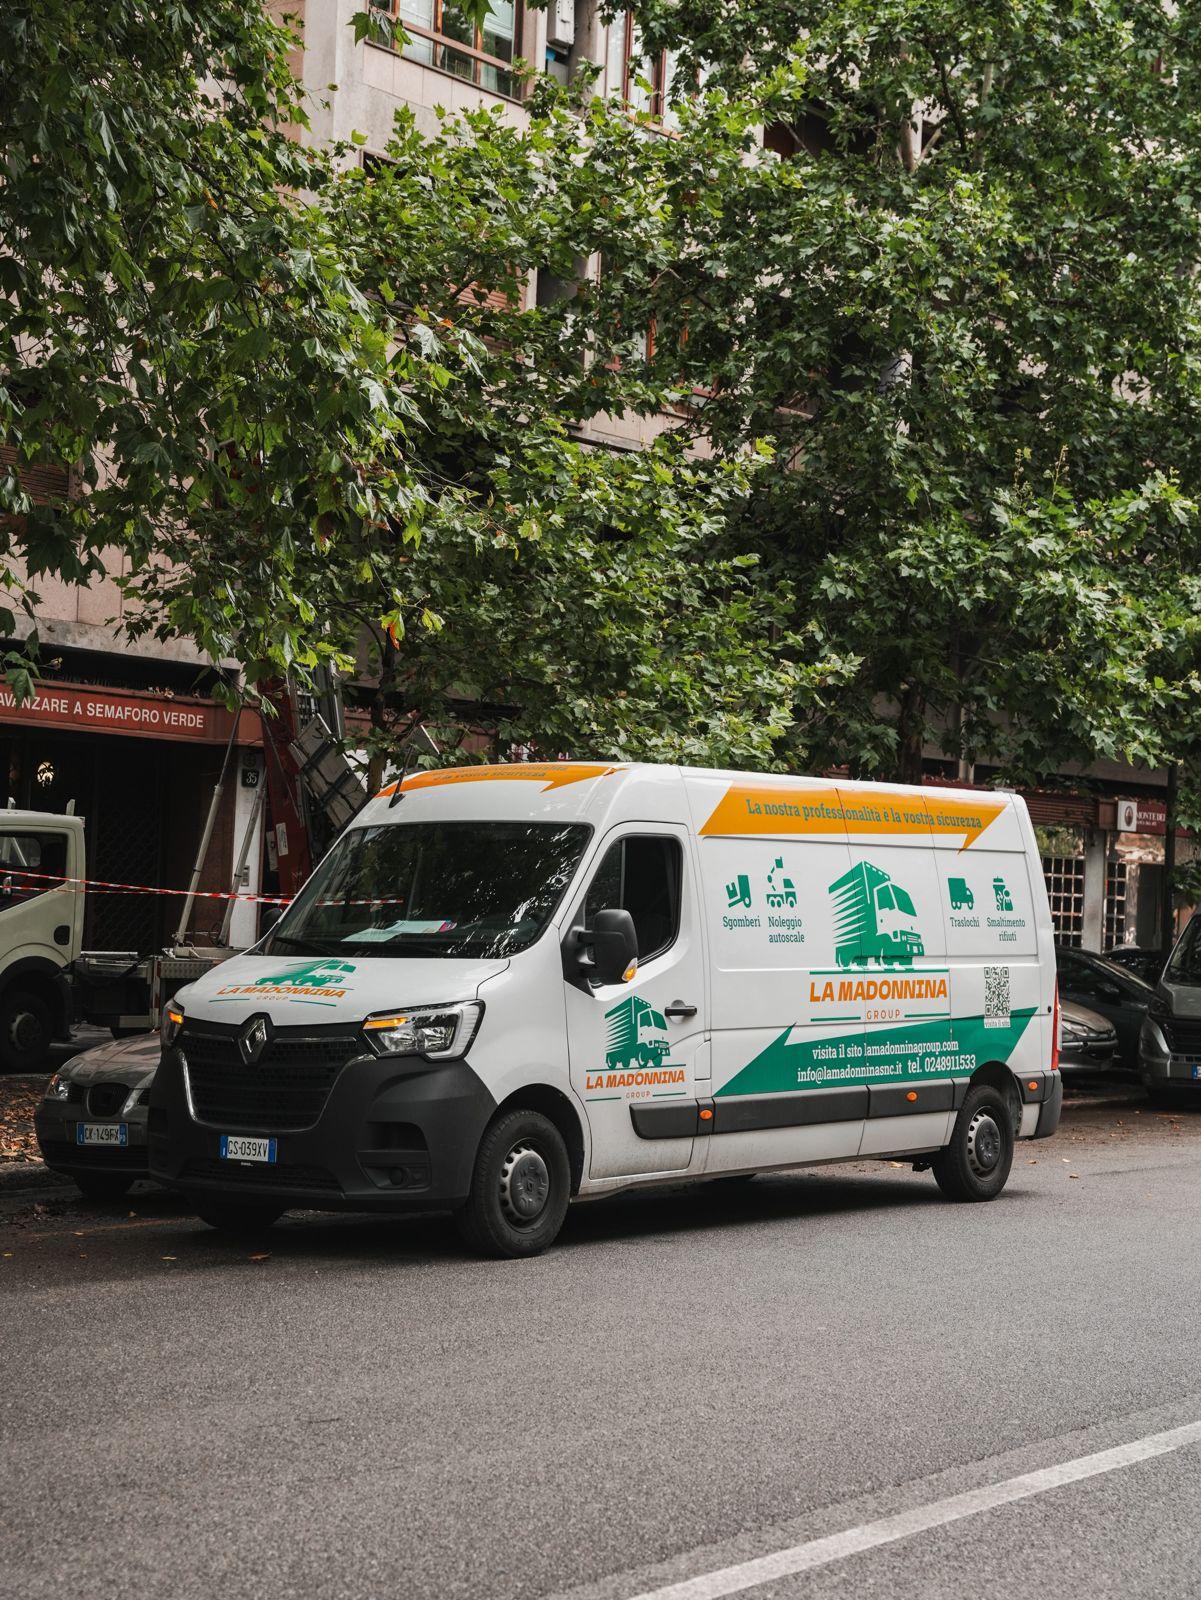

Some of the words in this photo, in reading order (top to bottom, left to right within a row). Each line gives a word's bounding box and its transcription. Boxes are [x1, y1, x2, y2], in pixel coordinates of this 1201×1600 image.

[73, 701, 83, 714] A
[87, 702, 159, 723] SEMAFORO
[163, 711, 204, 728] VERDE
[246, 772, 257, 784] 35
[746, 799, 761, 814] La
[764, 803, 800, 816] nostra
[802, 803, 881, 822] professionalità
[890, 808, 901, 823] la
[903, 812, 934, 826] vostra
[937, 811, 982, 828] sicurezza
[723, 915, 761, 930] Sgomberi
[768, 916, 802, 930] Noleggio
[950, 916, 980, 927] Traslochi
[987, 917, 1026, 928] Smaltimento
[768, 931, 805, 943] autoscale
[999, 931, 1017, 942] rifiuti
[217, 987, 238, 995] LA
[240, 986, 346, 998] MADONNINA
[810, 981, 835, 1002] LA
[838, 979, 948, 1001] MADONNINA
[866, 1009, 900, 1020] GROUP
[812, 1046, 837, 1060] visita
[839, 1044, 845, 1058] il
[847, 1043, 862, 1057] sito
[864, 1040, 959, 1056] lamadonninagroup.com
[797, 1061, 903, 1083] info@lamadonninasnc.it
[907, 1058, 922, 1073] tel.
[924, 1055, 976, 1072] 0248911533
[586, 1076, 603, 1089] LA
[606, 1070, 685, 1088] MADONNINA
